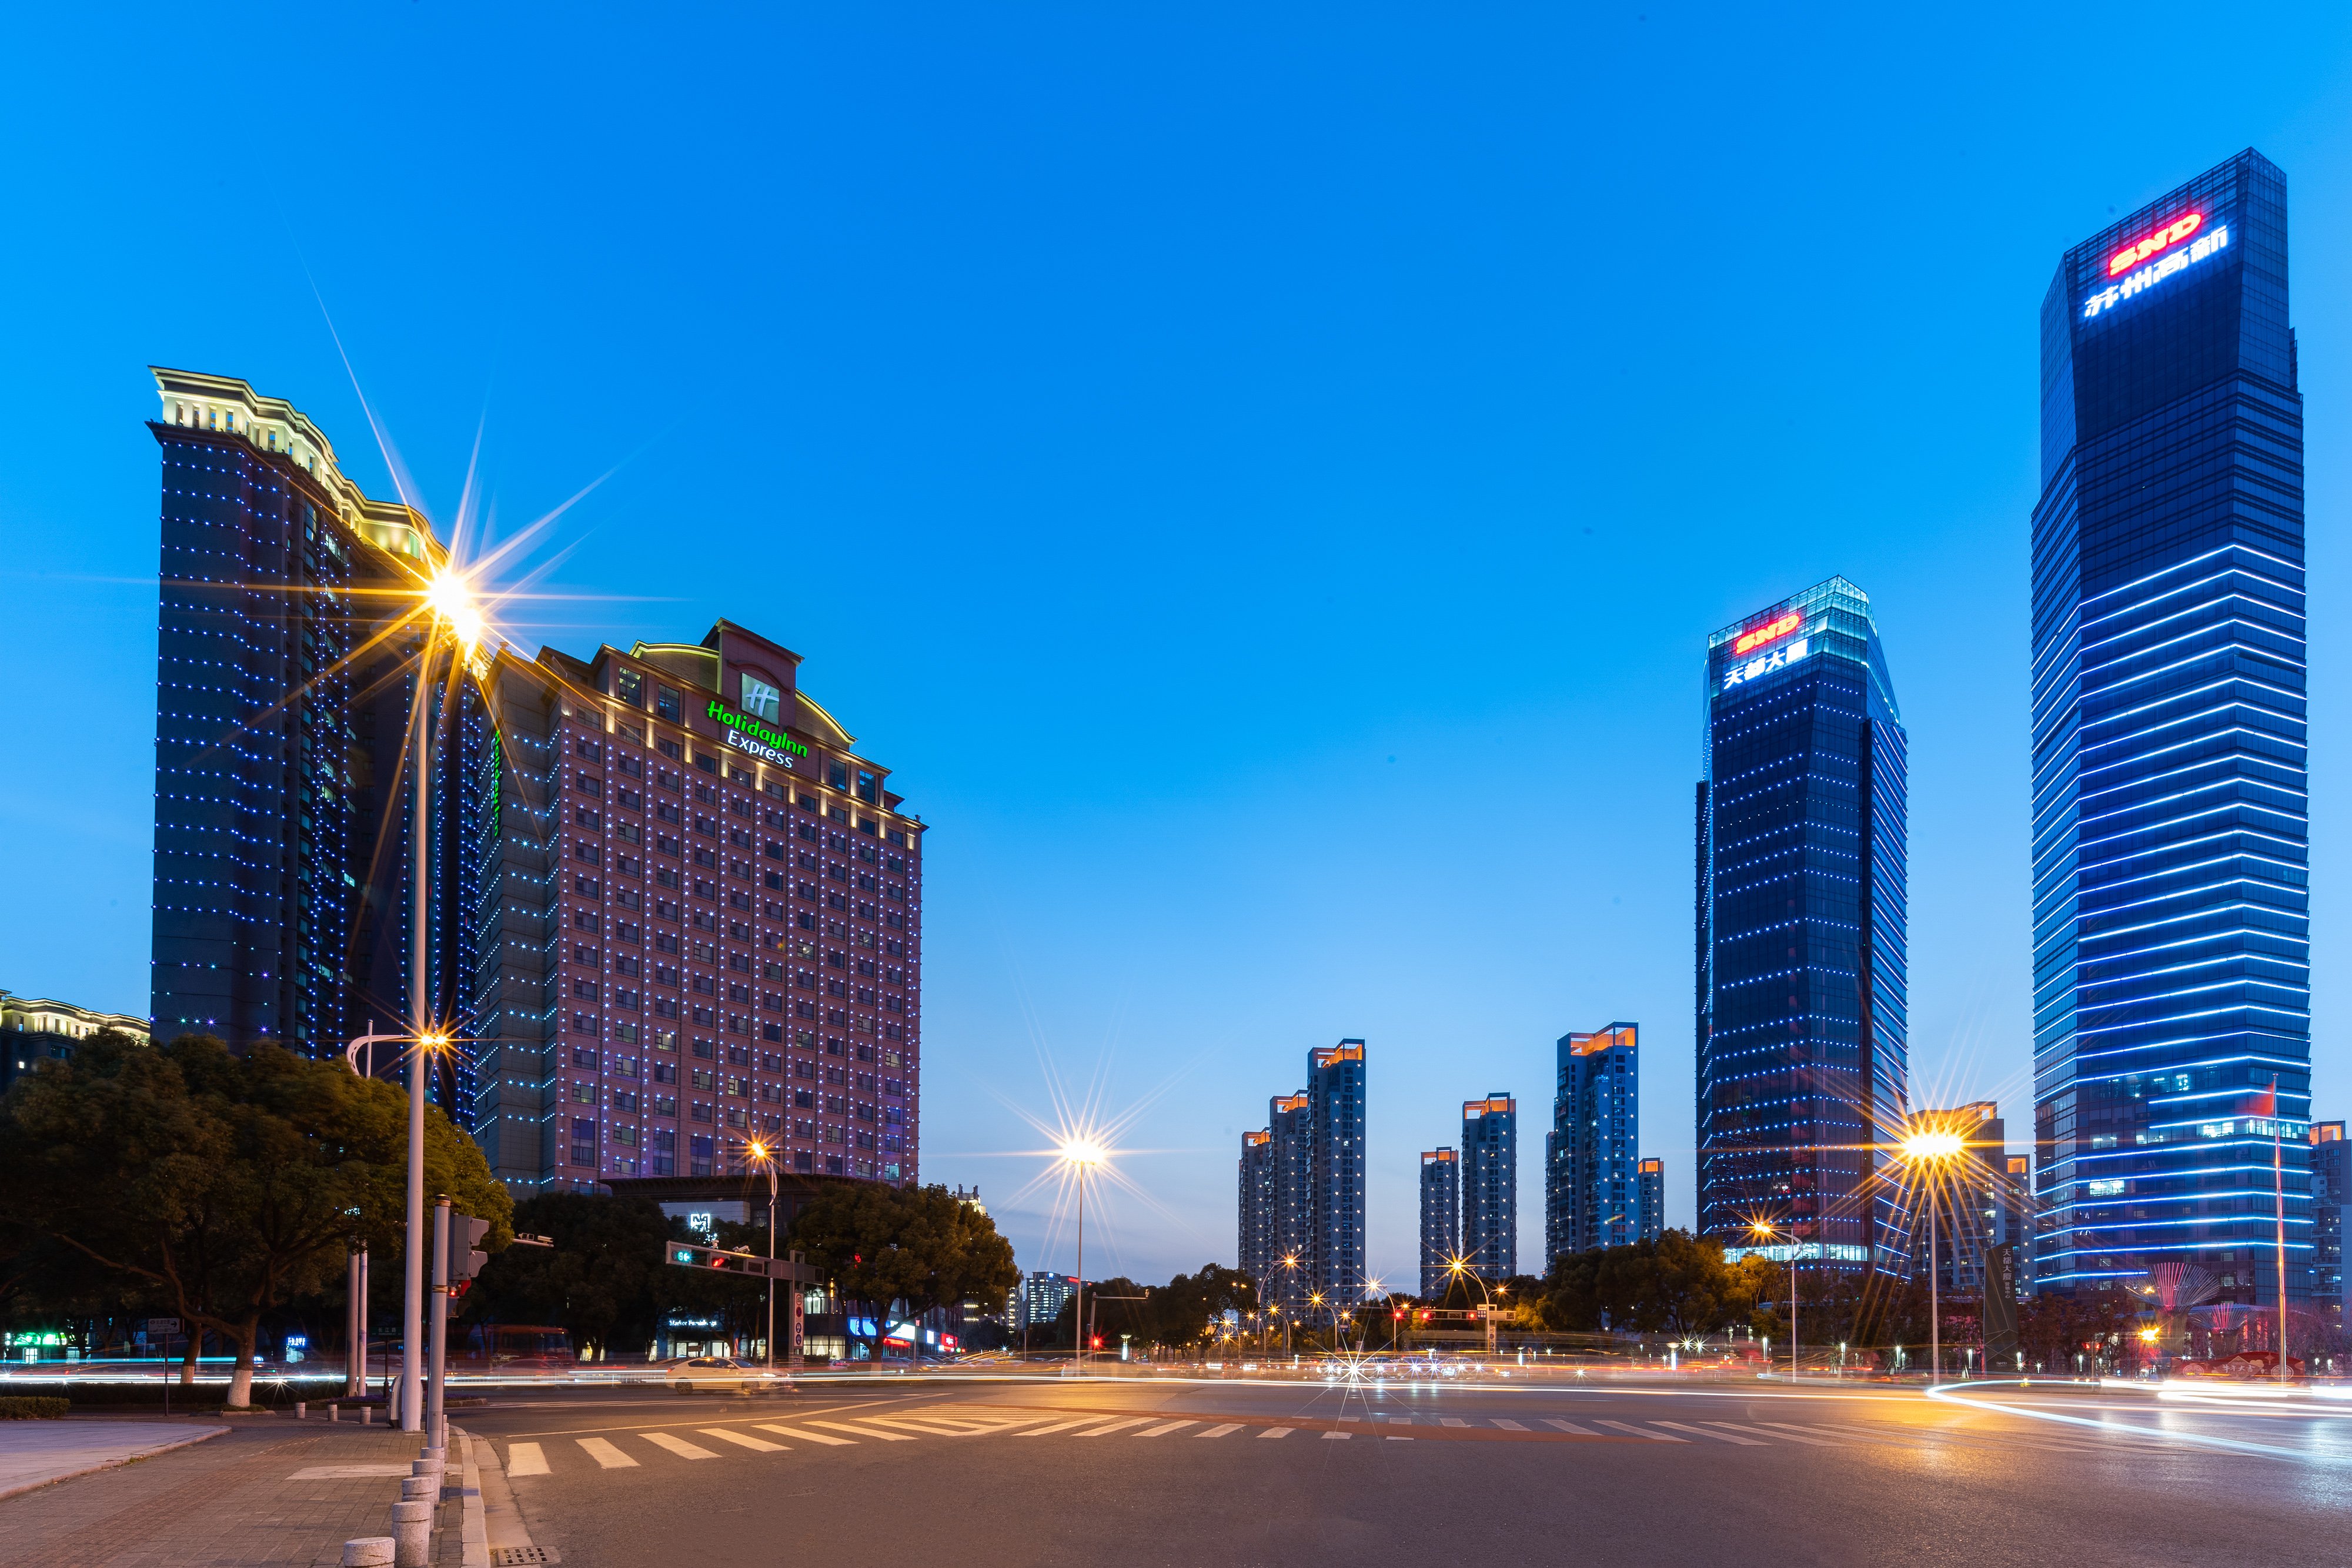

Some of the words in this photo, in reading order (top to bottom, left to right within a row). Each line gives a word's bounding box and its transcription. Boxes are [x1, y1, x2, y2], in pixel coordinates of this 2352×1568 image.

[2110, 214, 2201, 276] SND
[2084, 225, 2227, 317] 苏州高新
[1736, 614, 1799, 654] SND
[727, 729, 794, 769] Express
[2003, 1248, 2012, 1281] 天都大厦
